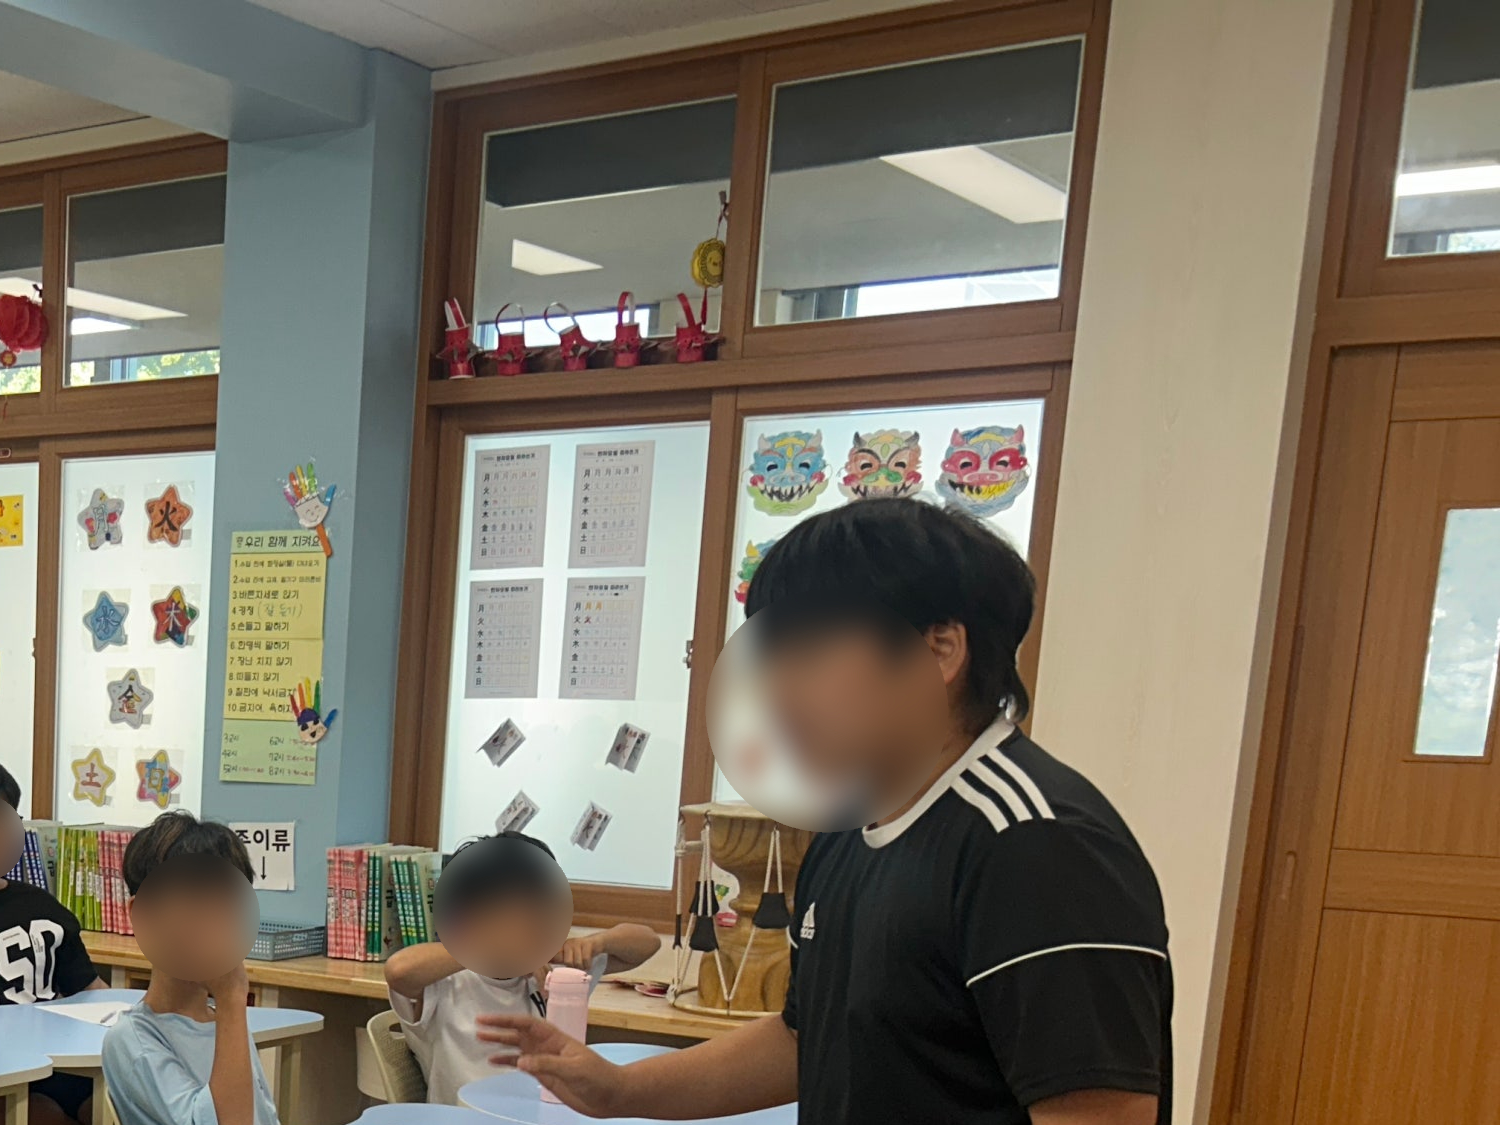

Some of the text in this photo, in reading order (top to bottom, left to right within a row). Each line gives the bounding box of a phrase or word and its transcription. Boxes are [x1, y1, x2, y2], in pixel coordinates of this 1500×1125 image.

[154, 501, 178, 532] 火
[245, 535, 320, 548] 우리 함께 지켜요
[163, 602, 182, 632] 木
[118, 684, 142, 714] 金
[80, 762, 102, 788] 土
